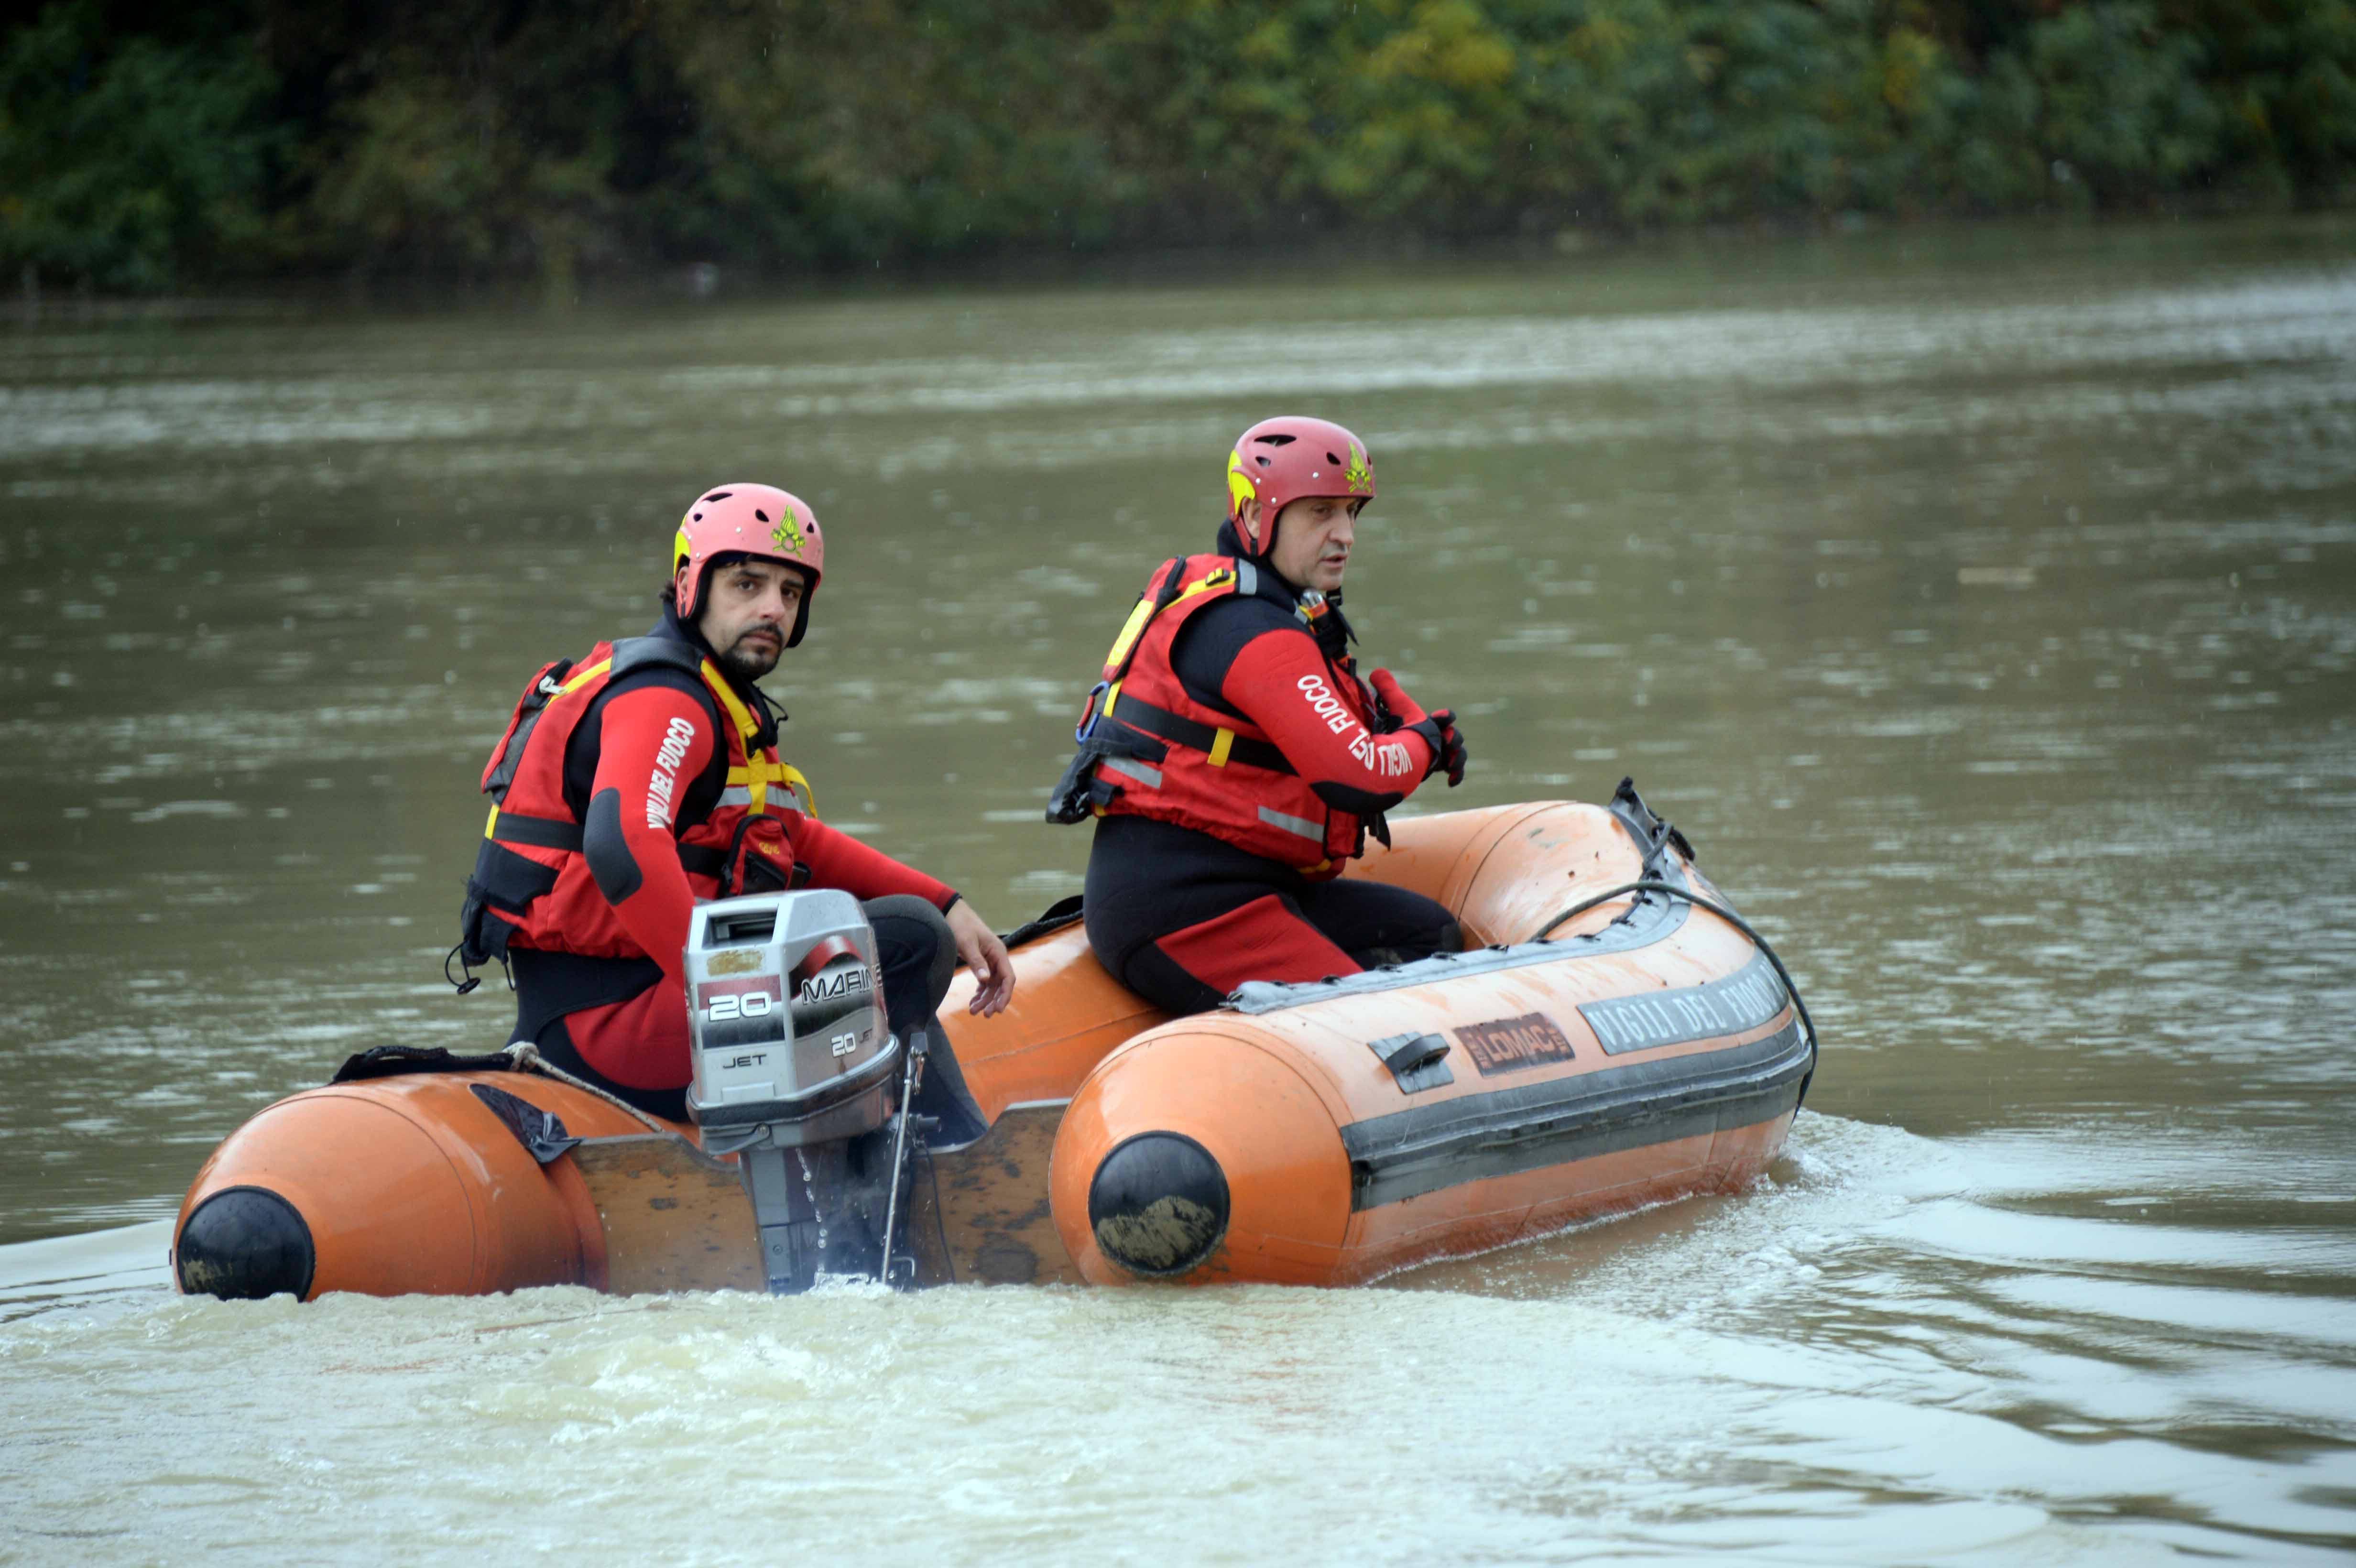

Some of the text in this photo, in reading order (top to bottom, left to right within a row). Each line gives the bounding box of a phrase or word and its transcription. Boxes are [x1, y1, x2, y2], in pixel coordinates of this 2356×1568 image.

[1297, 674, 1356, 735] FUOCO
[655, 717, 695, 778] FUOCO
[1347, 727, 1375, 771] DEL
[649, 768, 674, 804] DEL
[708, 991, 772, 1022] 20
[1586, 1000, 1678, 1046] VIGILI
[1672, 993, 1728, 1033] DEL
[722, 1054, 767, 1069] JET
[831, 1032, 856, 1058] 20
[1477, 1024, 1556, 1063] LOMAC
